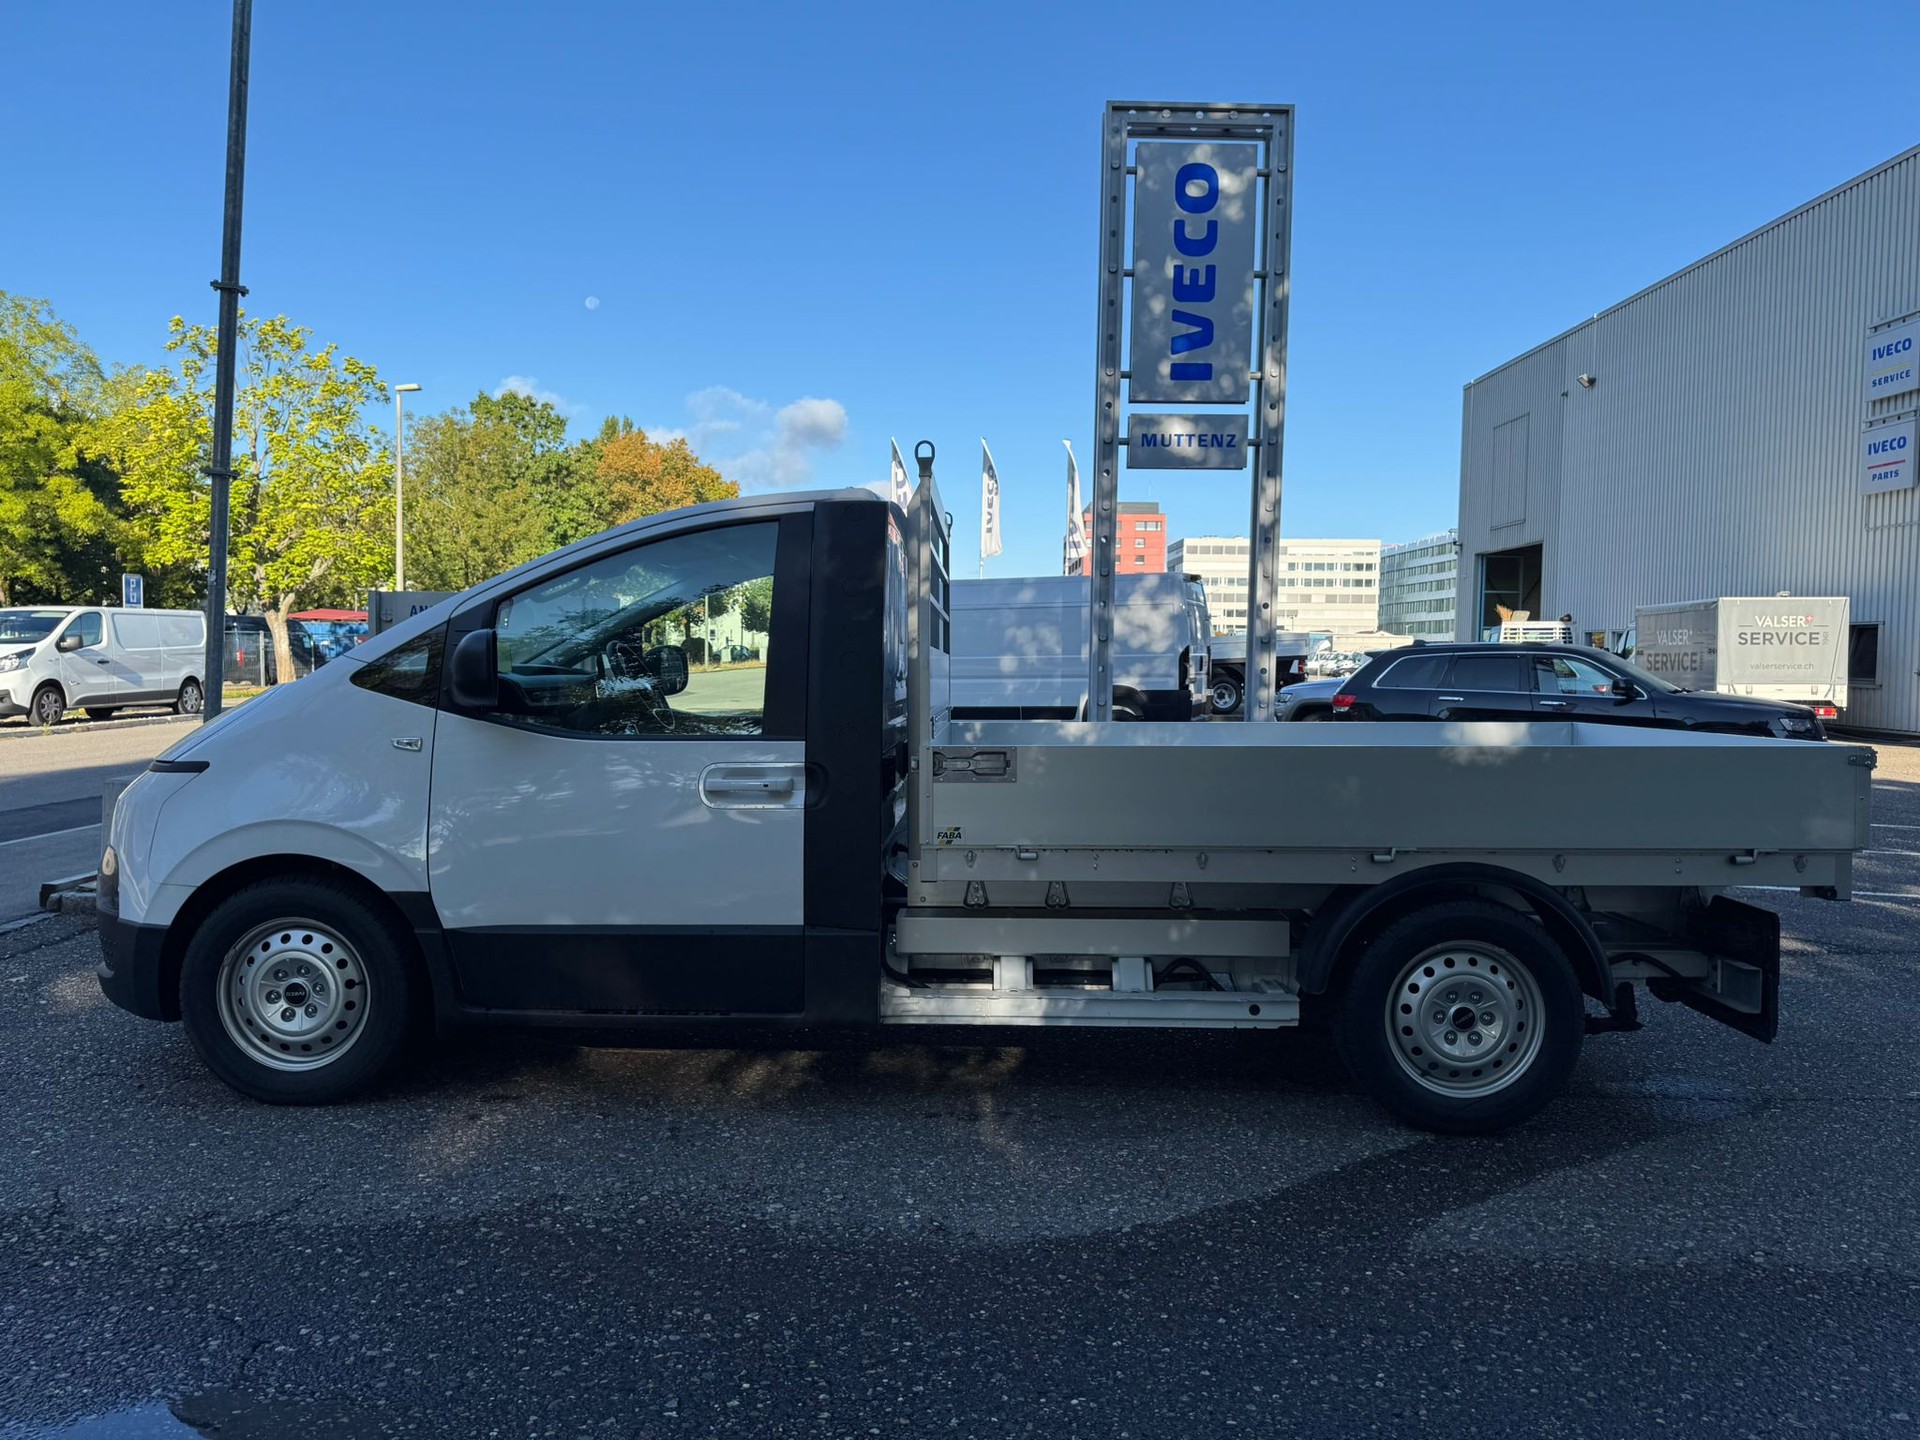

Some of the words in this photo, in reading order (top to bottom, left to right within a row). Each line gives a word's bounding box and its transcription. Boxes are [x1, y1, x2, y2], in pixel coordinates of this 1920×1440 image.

[1169, 162, 1220, 381] IVECO
[1872, 337, 1912, 361] IVECO
[1871, 369, 1911, 388] SERVICE
[1140, 433, 1237, 448] MUTTENZ
[1867, 435, 1907, 456] IVECO
[1871, 469, 1900, 482] PARTS
[986, 464, 995, 534] IVECO
[1755, 615, 1806, 628] VALSER
[1656, 629, 1690, 646] VALSER
[1738, 631, 1820, 646] SERVICE
[1646, 652, 1698, 672] SERVICE
[1749, 661, 1815, 671] valserservice.ch
[937, 831, 962, 840] FABA
